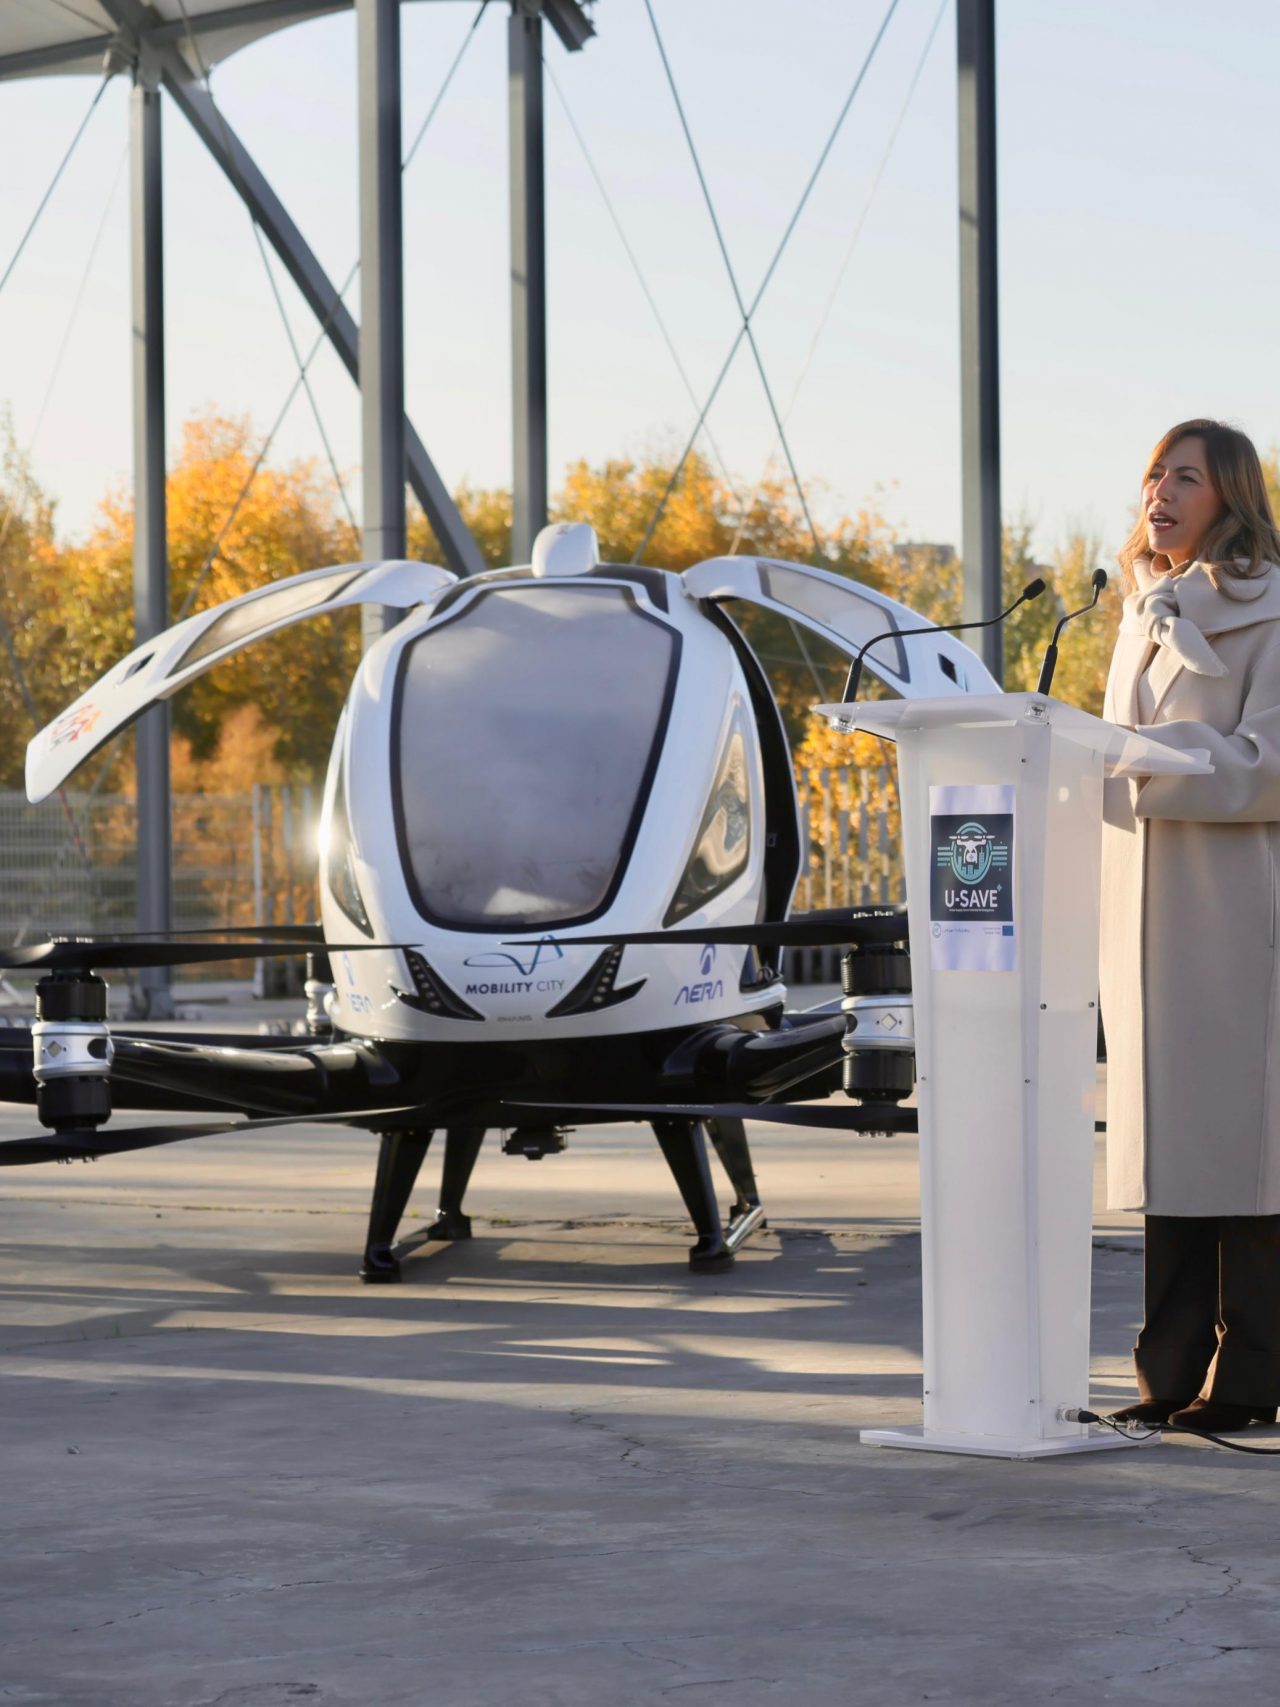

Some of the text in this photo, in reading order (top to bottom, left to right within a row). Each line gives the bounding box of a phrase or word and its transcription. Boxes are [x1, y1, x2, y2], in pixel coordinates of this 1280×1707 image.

[944, 889, 998, 908] U-SAVE
[465, 980, 565, 995] MOBILITY CITY
